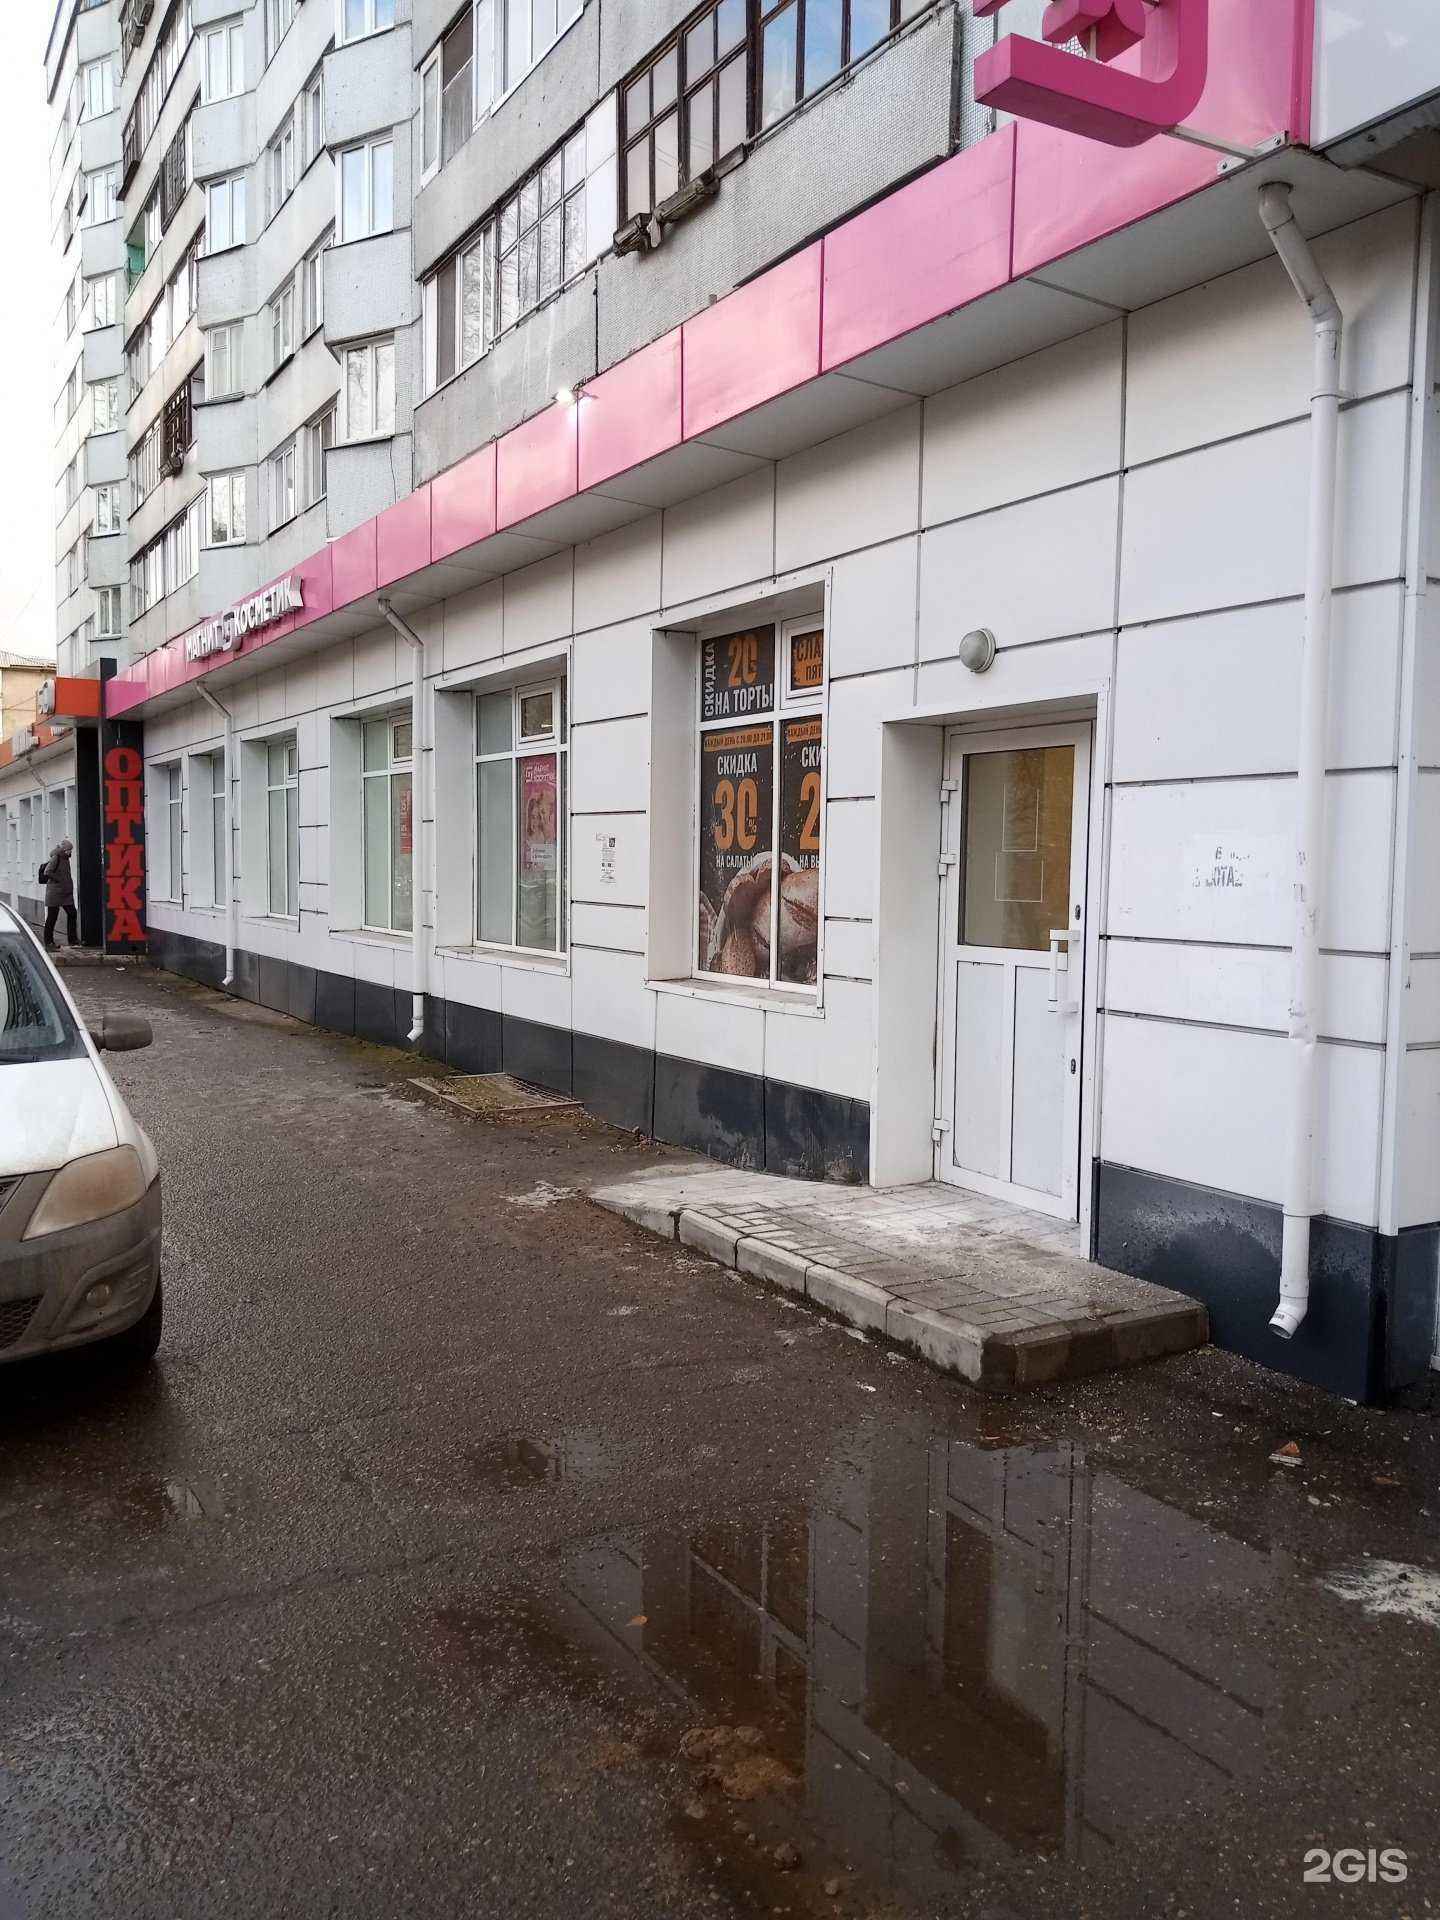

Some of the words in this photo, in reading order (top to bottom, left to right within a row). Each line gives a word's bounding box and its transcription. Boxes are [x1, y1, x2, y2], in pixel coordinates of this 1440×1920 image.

[185, 620, 223, 662] МАГНИТ
[234, 576, 303, 637] КОСМЕТИК
[704, 642, 717, 717] СКИДКА
[715, 691, 730, 715] НА
[733, 683, 773, 712] ТОРТЫ
[717, 753, 758, 777] СКИДКА
[104, 747, 148, 941] ОПТИКА
[716, 855, 725, 868] НА
[726, 855, 753, 868] САЛАТЫ
[800, 854, 809, 869] НА
